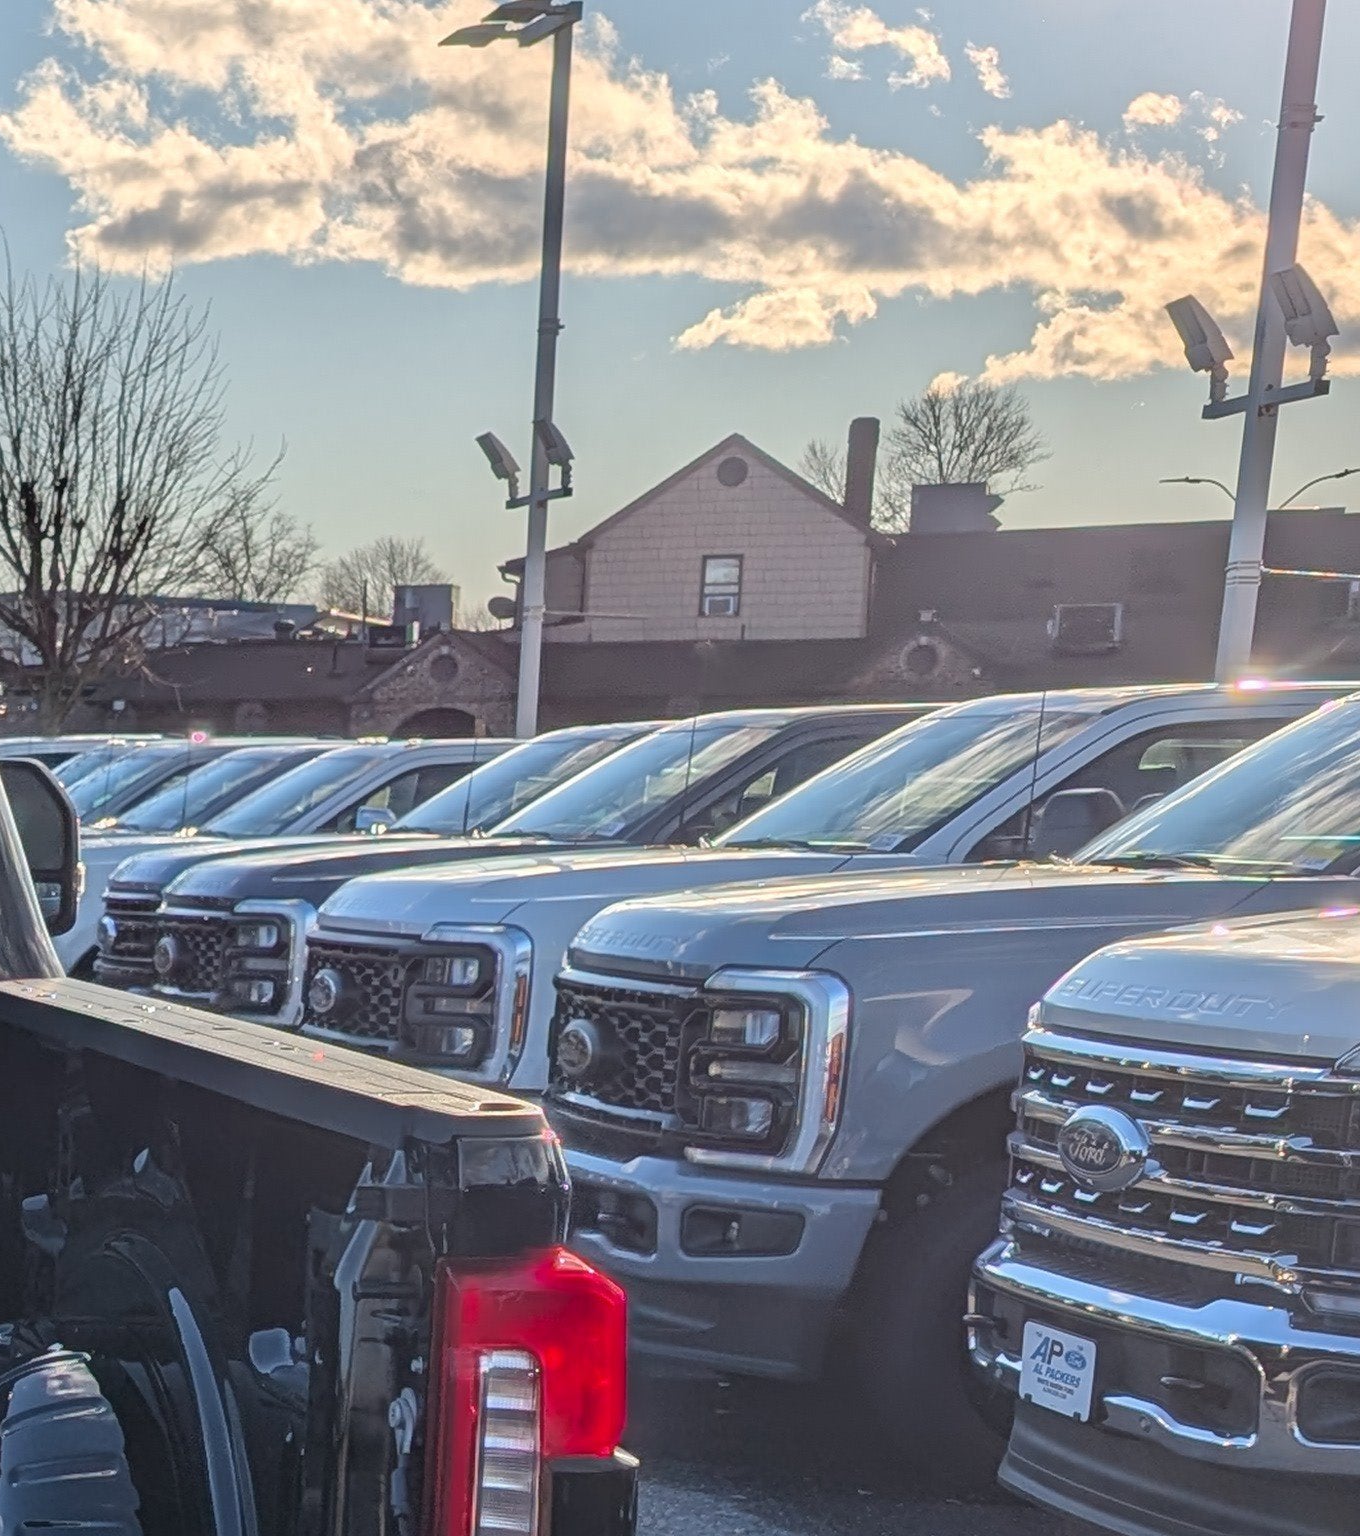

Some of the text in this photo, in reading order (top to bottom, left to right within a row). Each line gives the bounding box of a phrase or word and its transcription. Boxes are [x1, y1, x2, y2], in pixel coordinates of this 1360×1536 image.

[1059, 977, 1294, 1020] SUPER DUTY
[1067, 1127, 1111, 1166] Ford
[1030, 1336, 1064, 1366] AP
